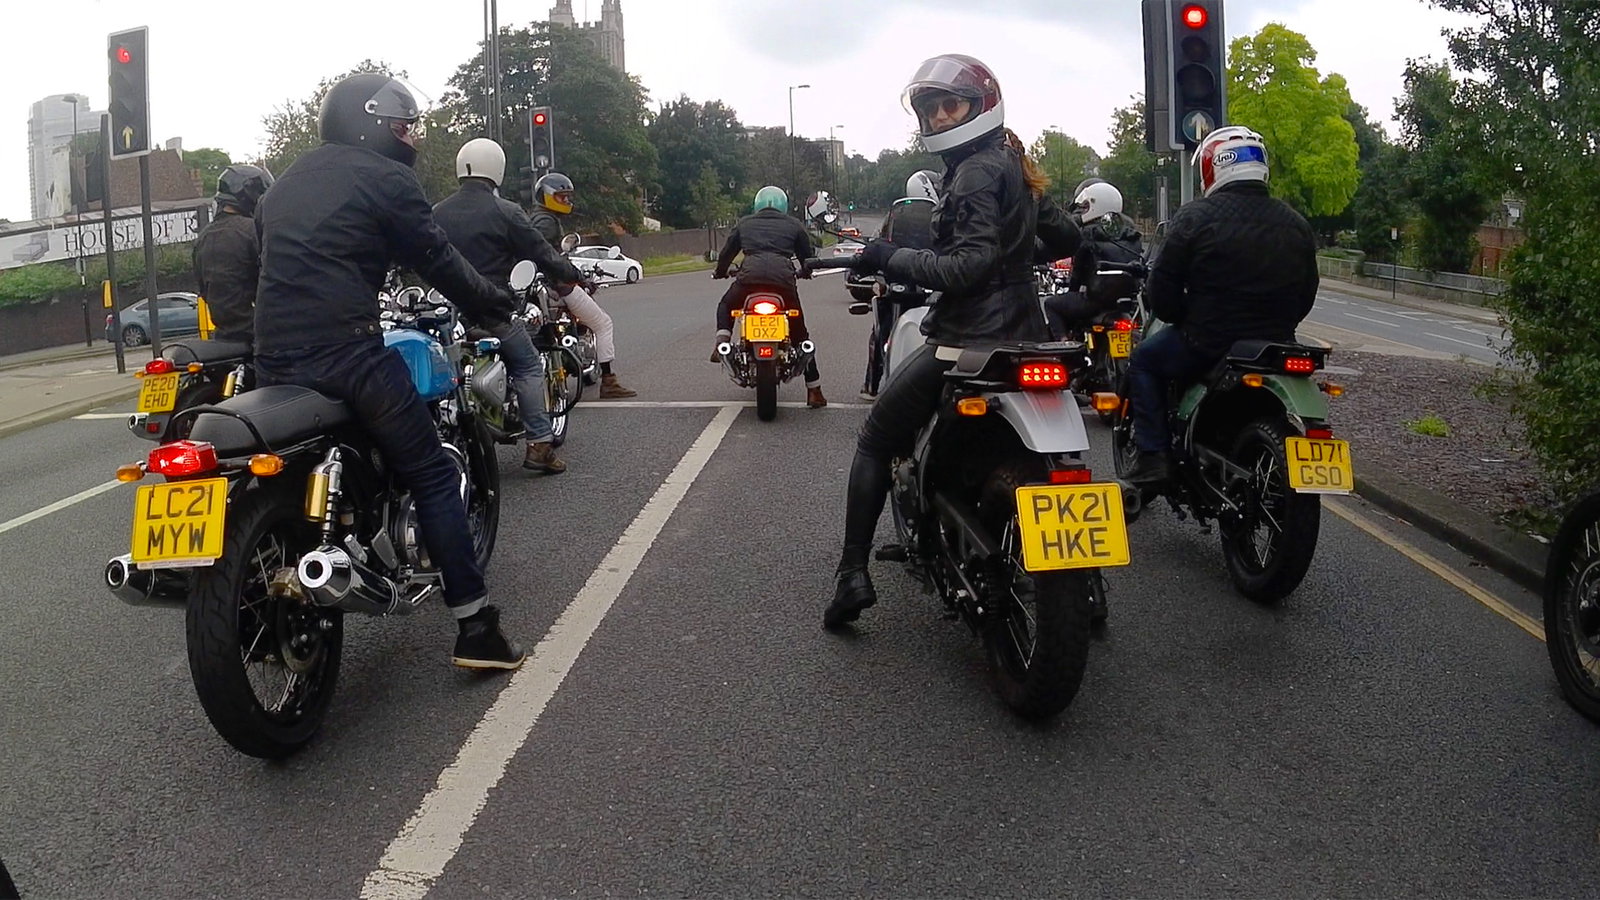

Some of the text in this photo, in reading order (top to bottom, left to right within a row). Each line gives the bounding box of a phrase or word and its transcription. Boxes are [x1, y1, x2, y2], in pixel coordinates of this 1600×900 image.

[751, 317, 780, 328] LE21
[143, 376, 176, 393] PE20
[144, 392, 169, 409] EHD
[1295, 441, 1342, 463] LD71
[1301, 465, 1342, 486] GSO
[146, 484, 214, 520] LC21
[1032, 492, 1110, 525] PK21
[147, 521, 206, 556] MYW
[1041, 527, 1111, 560] HKE
